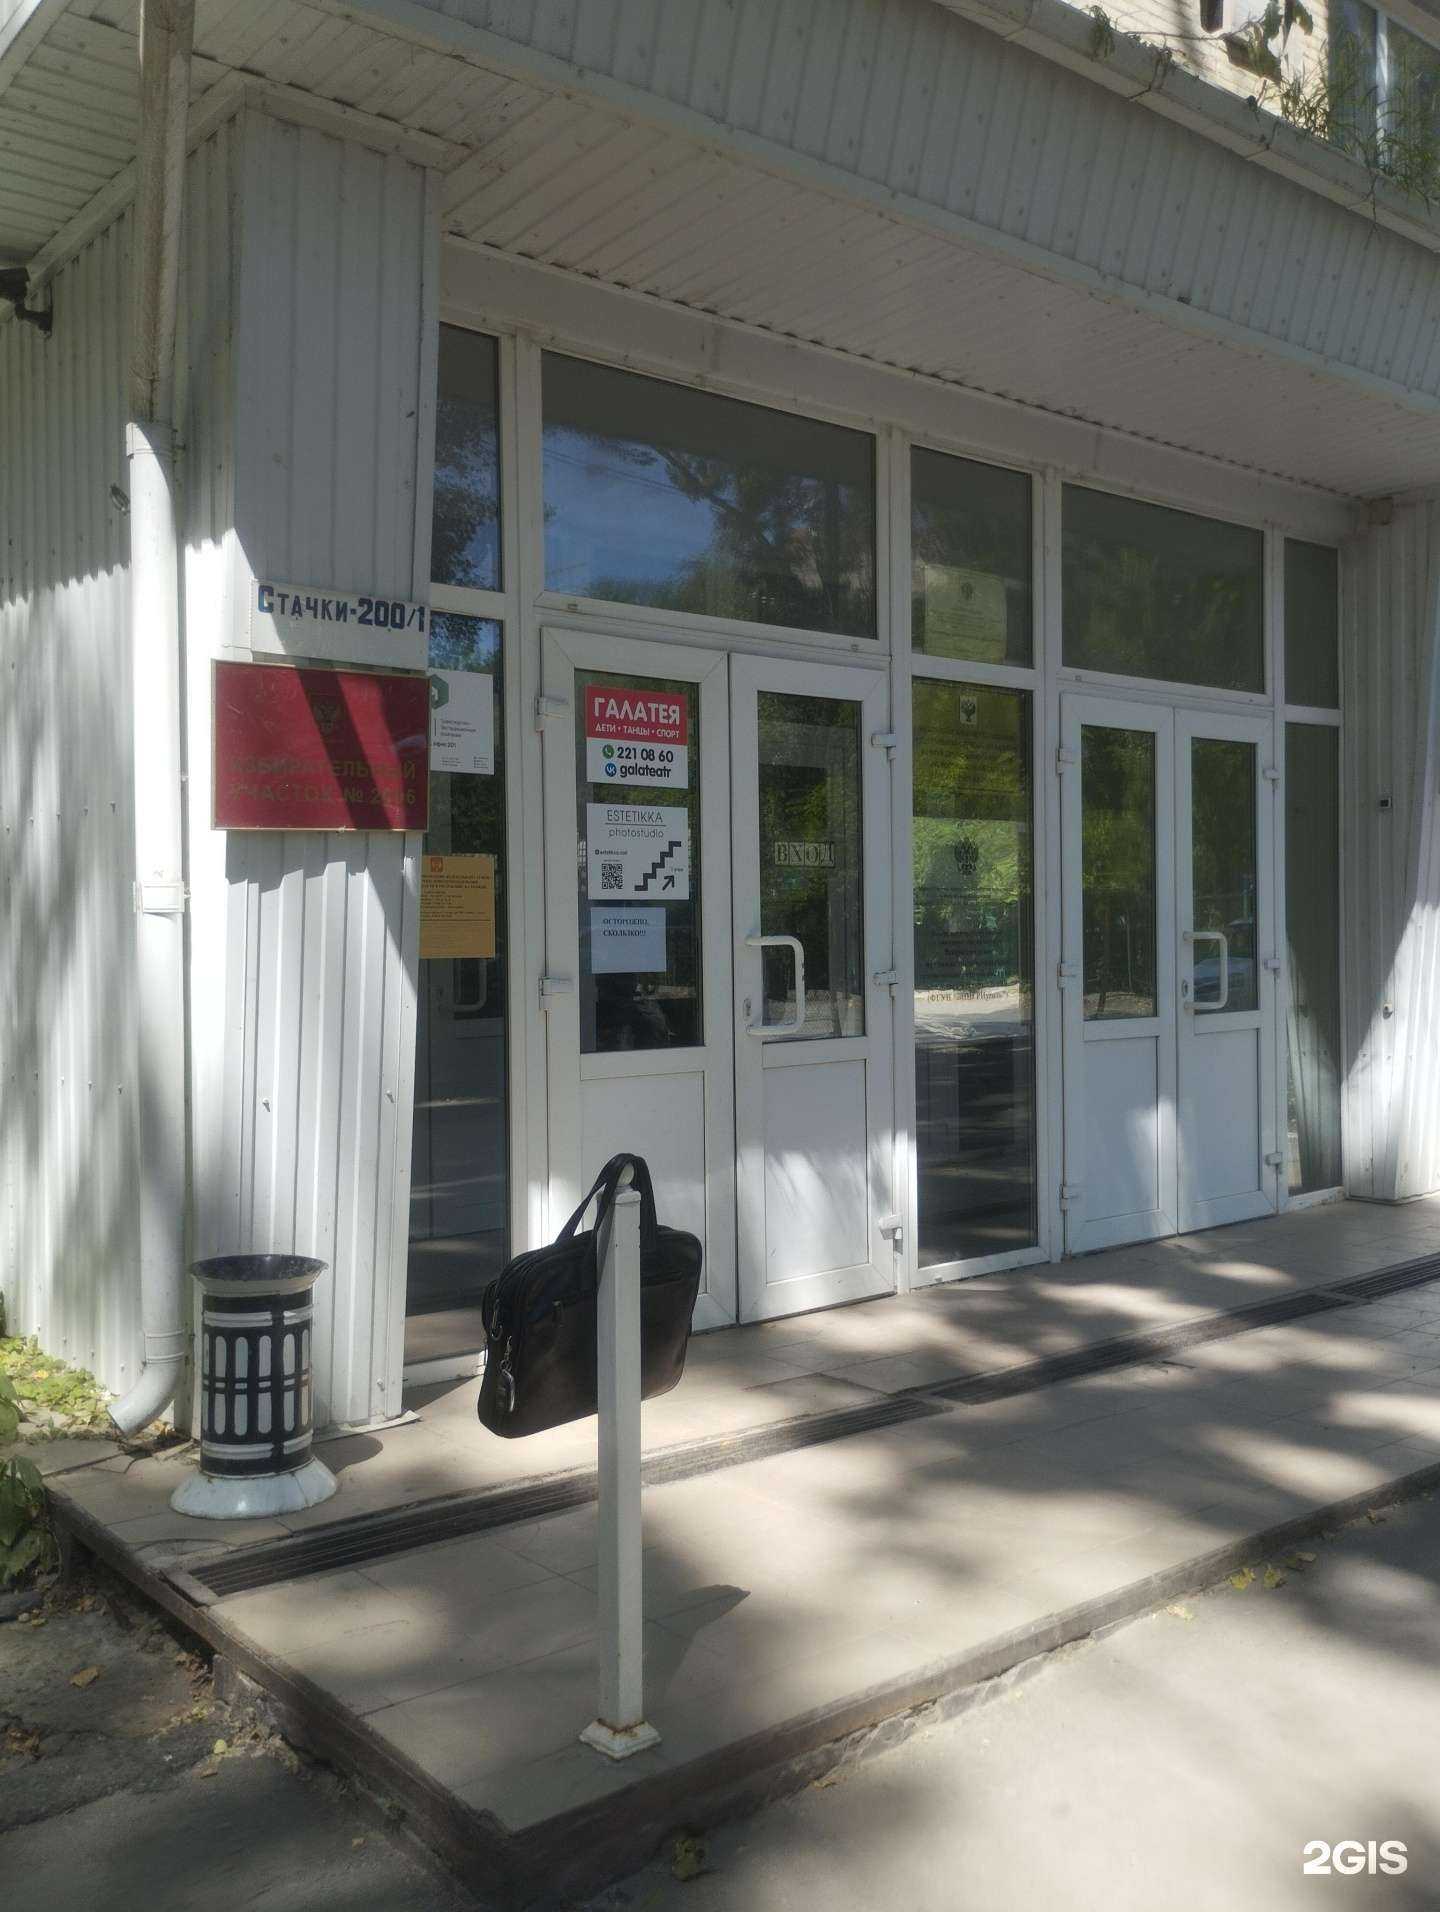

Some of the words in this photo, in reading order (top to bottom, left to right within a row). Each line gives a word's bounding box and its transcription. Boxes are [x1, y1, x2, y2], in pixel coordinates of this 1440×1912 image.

[594, 697, 681, 726] ГАЛАТЕЯ
[595, 722, 616, 734] ДЕТИ
[623, 725, 650, 737] ТАНЦЫ
[656, 728, 680, 739] СПОРТ
[617, 746, 637, 760] 221
[640, 748, 655, 762] 08
[658, 750, 674, 763] 60
[620, 763, 672, 778] galateatr
[606, 809, 664, 824] ESTETIKKA
[608, 827, 665, 840] photostudio
[776, 841, 834, 864] ВХОД
